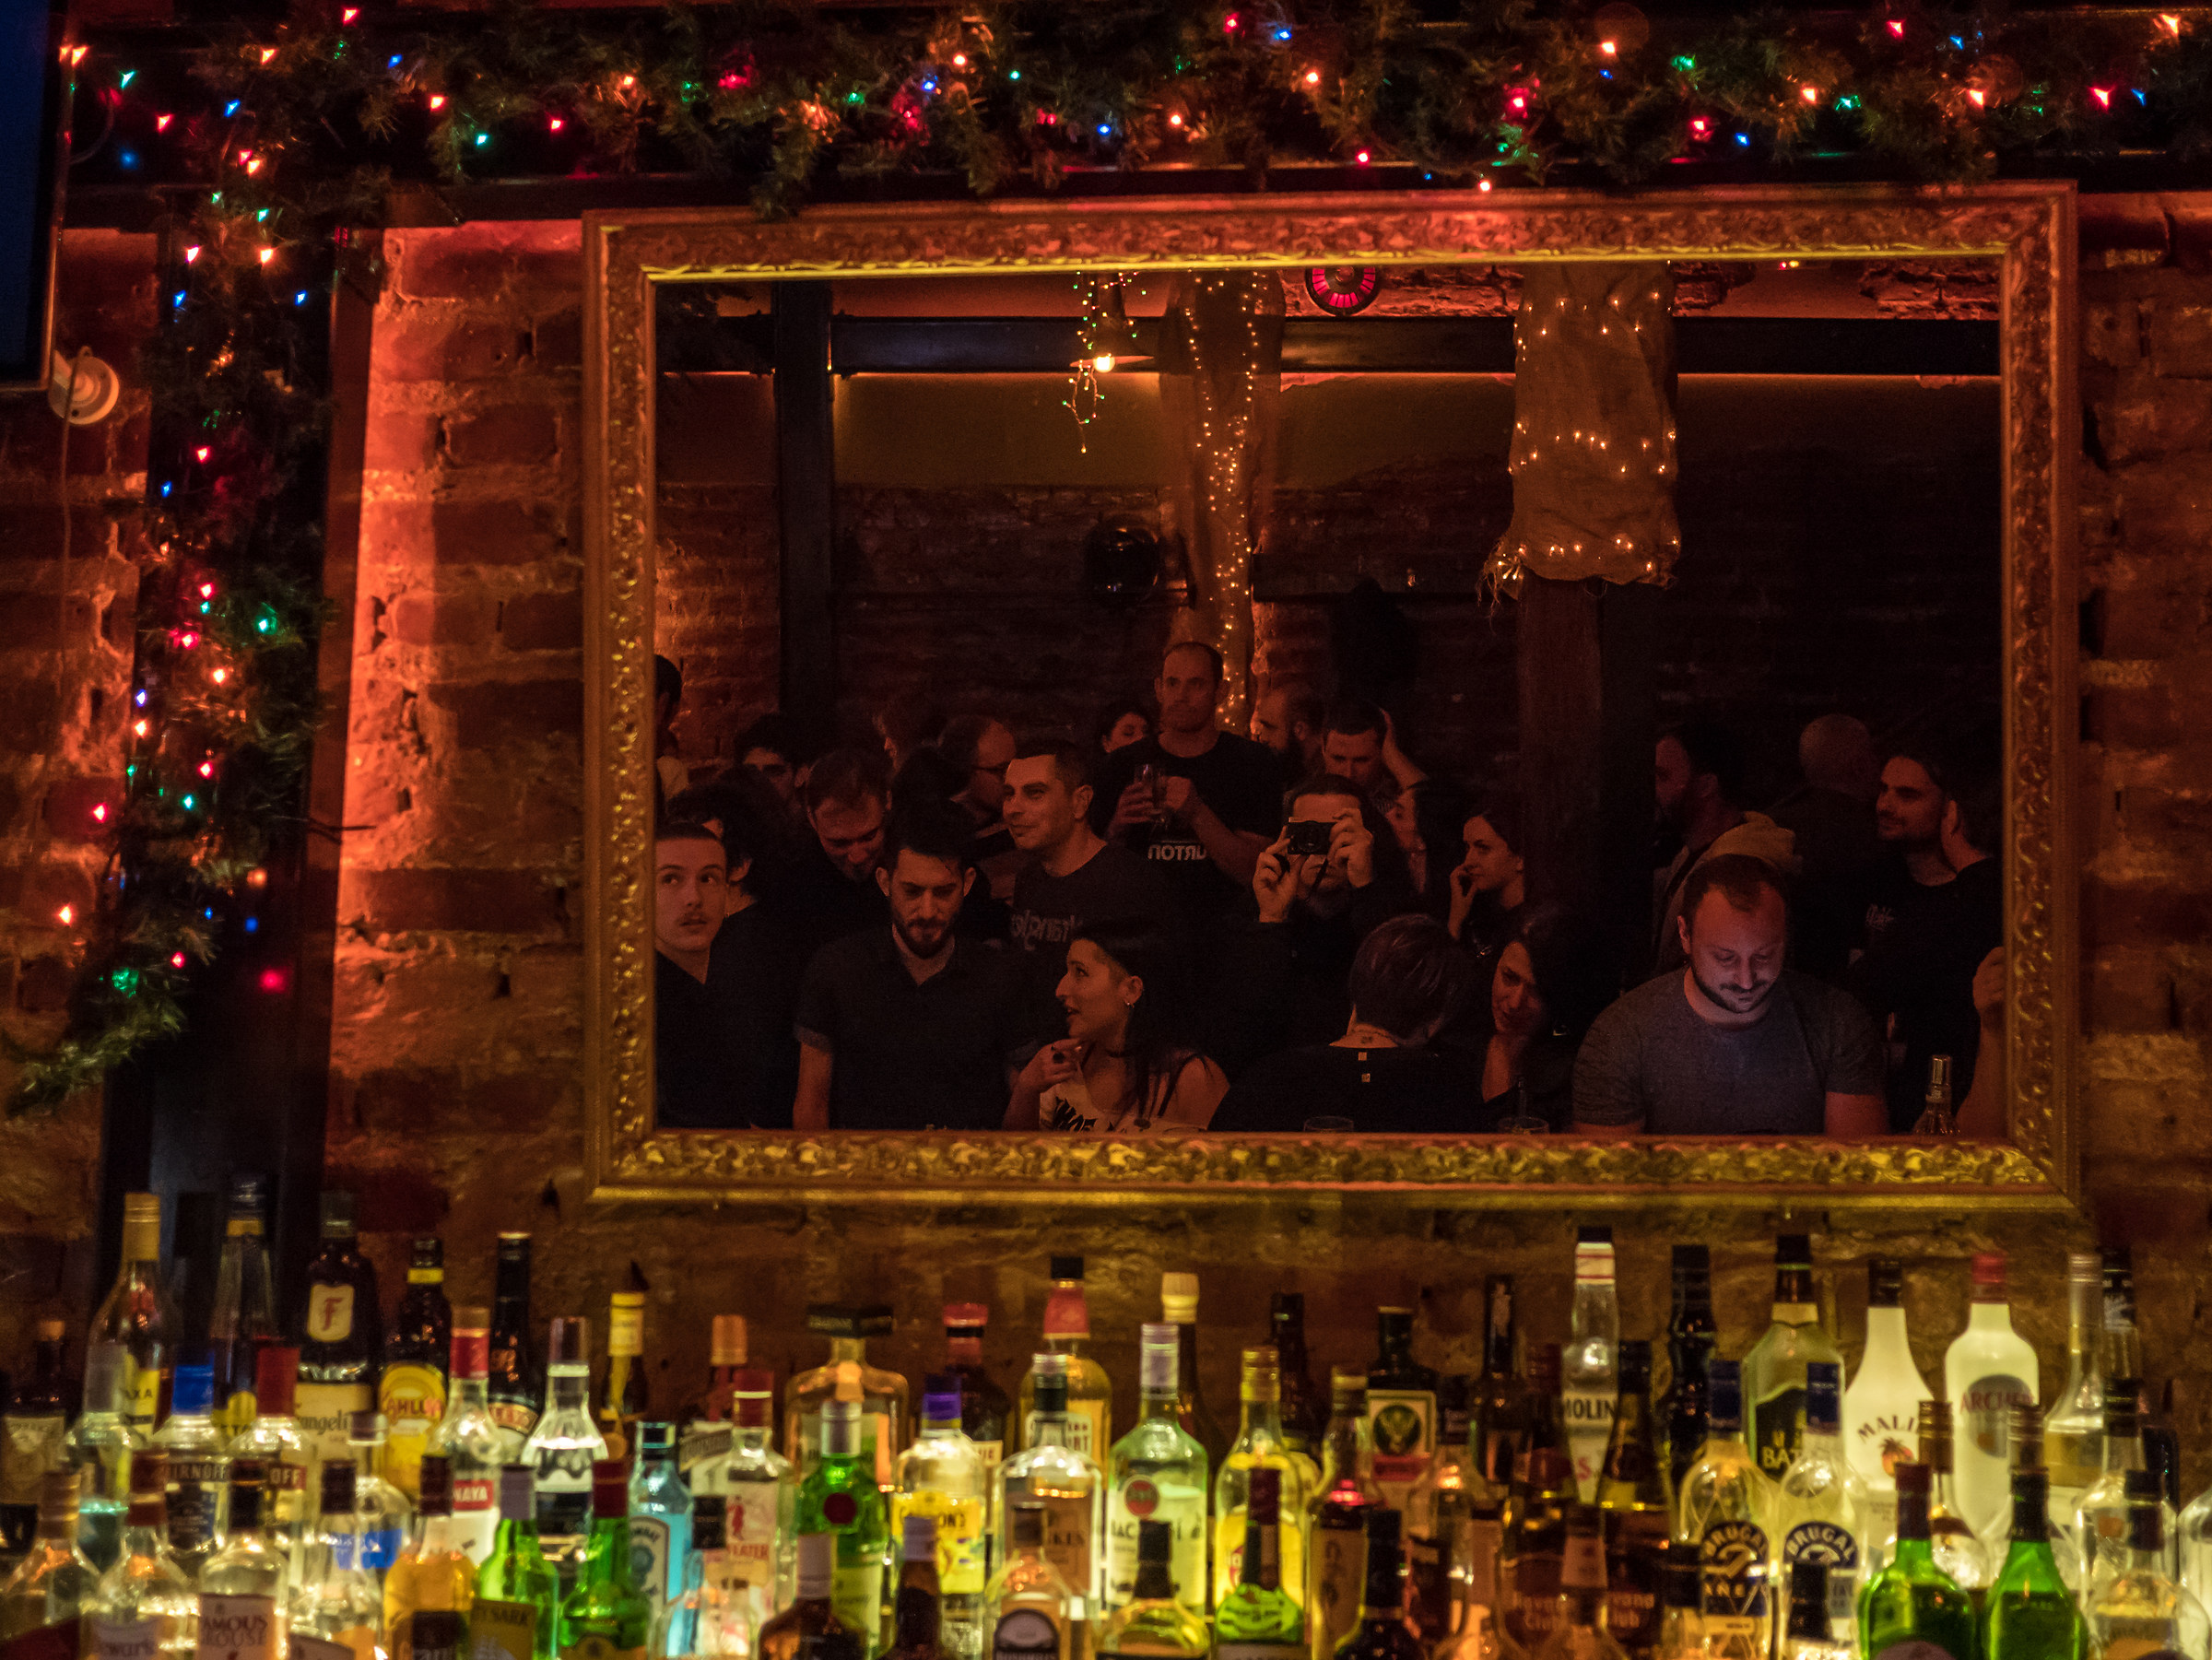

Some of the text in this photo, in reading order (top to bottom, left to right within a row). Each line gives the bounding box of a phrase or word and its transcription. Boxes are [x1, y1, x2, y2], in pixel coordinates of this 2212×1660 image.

[1857, 1414, 1916, 1444] MALI
[1761, 1445, 1804, 1469] BAT
[269, 1467, 302, 1485] OFF
[453, 1486, 488, 1503] NAYA
[202, 1614, 268, 1631] AMOUS
